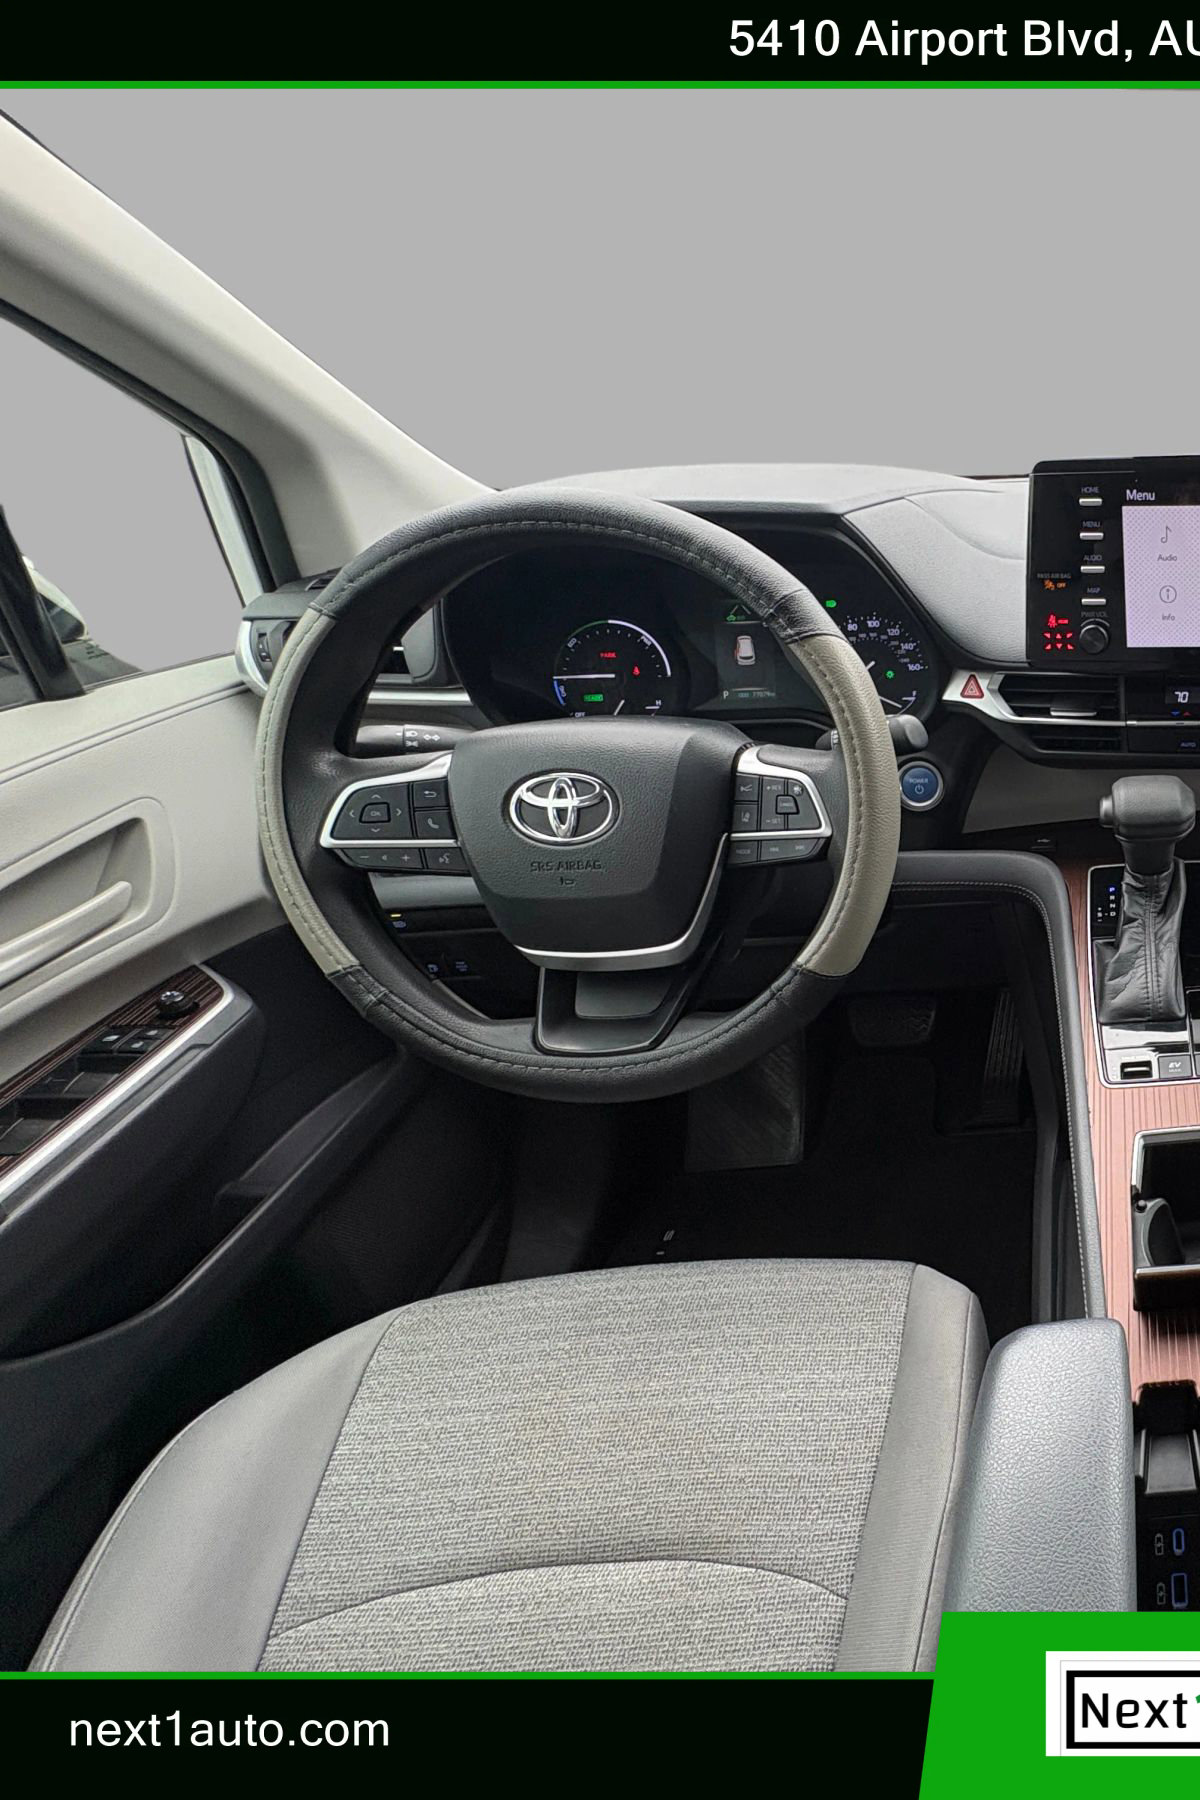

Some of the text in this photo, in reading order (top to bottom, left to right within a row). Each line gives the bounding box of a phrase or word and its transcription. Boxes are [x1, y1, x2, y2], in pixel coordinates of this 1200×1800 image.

[1126, 489, 1155, 500] Menu
[1157, 553, 1178, 561] Audio
[1162, 613, 1176, 621] Info
[847, 623, 858, 631] 80
[867, 620, 881, 628] 100
[901, 643, 914, 651] 140
[723, 690, 730, 699] P
[1174, 691, 1189, 703] 70
[530, 860, 602, 872] SRS AIRBAG
